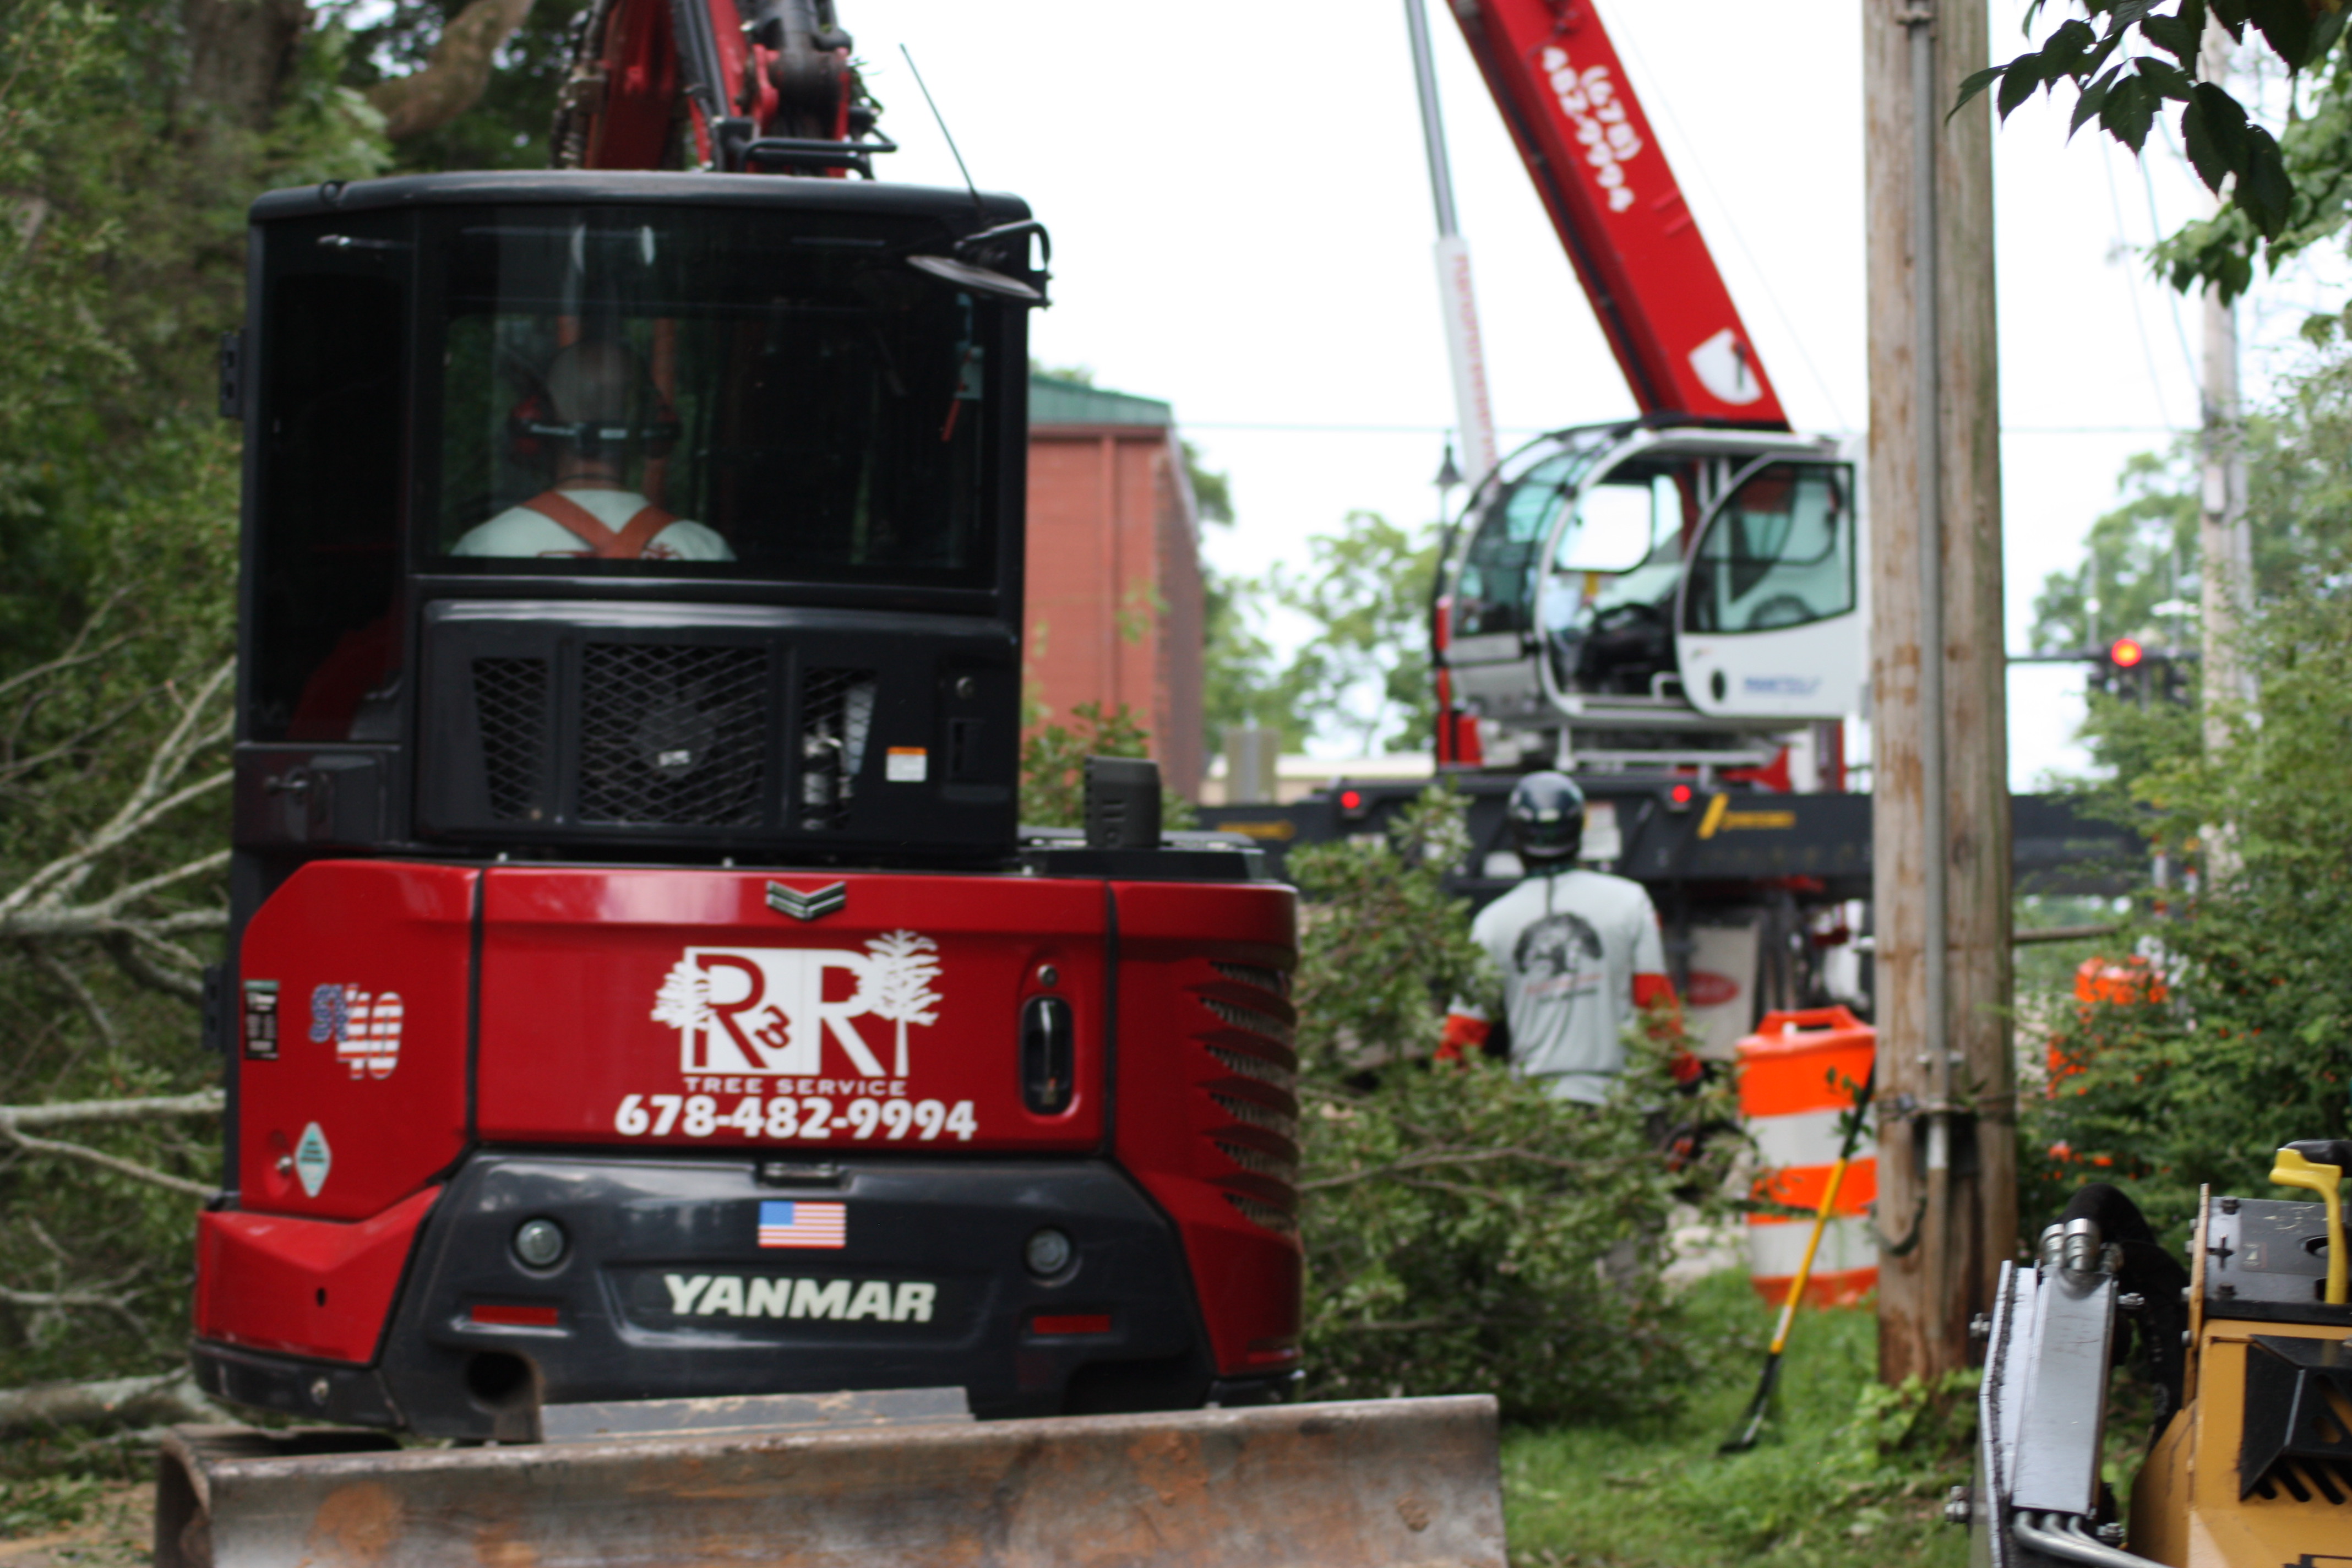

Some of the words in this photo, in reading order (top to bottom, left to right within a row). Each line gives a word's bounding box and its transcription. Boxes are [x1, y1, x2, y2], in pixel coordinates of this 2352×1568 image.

[1542, 47, 1636, 213] 482-9994
[1581, 65, 1643, 161] (678)
[683, 1076, 763, 1093] TREE
[776, 1077, 908, 1096] SERVICE
[615, 1094, 978, 1141] 678-482-9994
[663, 1275, 937, 1322] YANMAR
